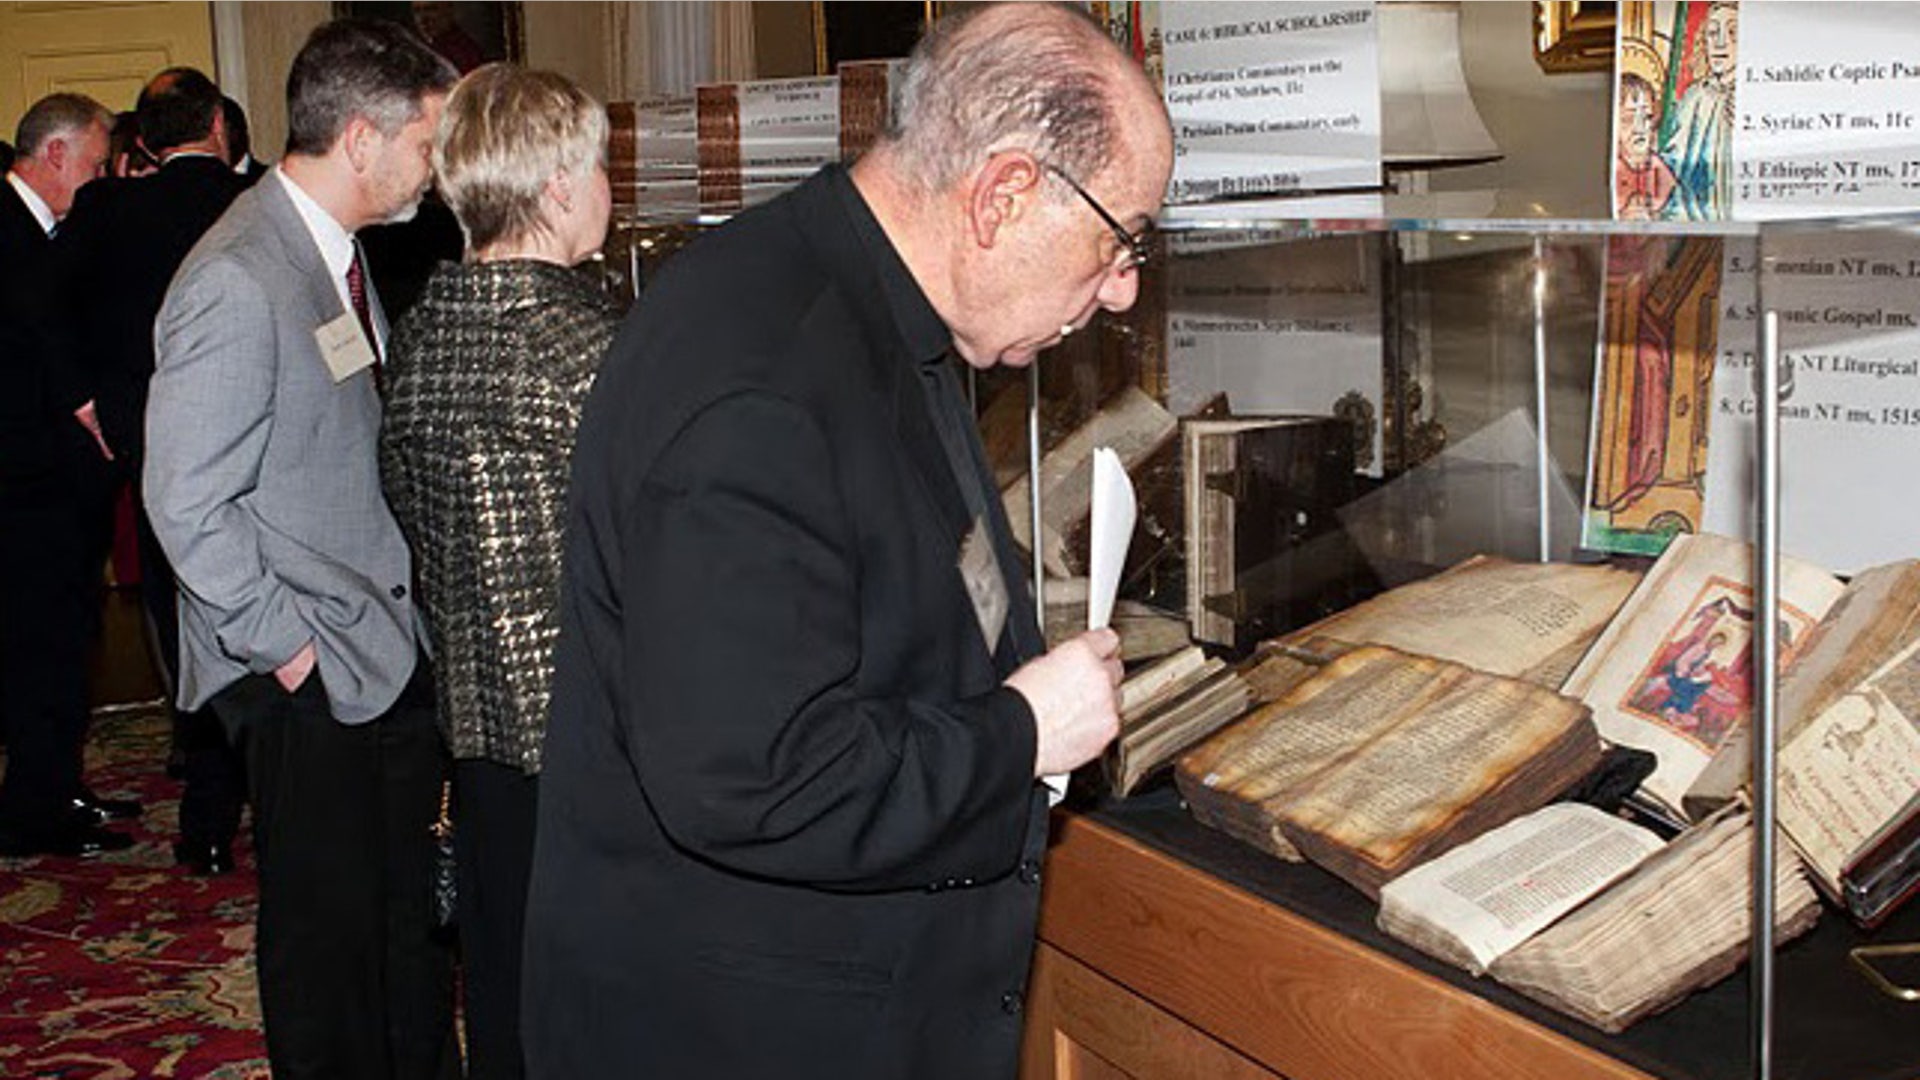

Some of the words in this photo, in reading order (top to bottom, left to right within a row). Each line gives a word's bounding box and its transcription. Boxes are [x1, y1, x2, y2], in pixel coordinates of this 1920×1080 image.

[1165, 29, 1196, 44] CASE
[1213, 20, 1272, 40] BIBLICAL
[1274, 9, 1372, 33] SCHOLARSHIP
[1237, 64, 1306, 82] Commentary
[1324, 60, 1342, 74] the
[1745, 66, 1759, 83] 1.
[1762, 66, 1825, 83] Sahidic
[1829, 63, 1887, 85] Coptic
[1168, 89, 1202, 106] Gospel
[1743, 114, 1756, 131] 2.
[1761, 113, 1815, 134] Syriac
[1819, 112, 1845, 130] NT
[1850, 115, 1880, 129] ms,
[1740, 161, 1753, 179] 3.
[1758, 161, 1828, 181] Ethiopic
[1833, 161, 1860, 178] NT
[1728, 256, 1745, 273] 5.
[1839, 258, 1868, 277] NT
[1726, 304, 1743, 320] 6.
[1824, 306, 1883, 328] Gospel
[1724, 351, 1738, 368] 7.
[1800, 355, 1828, 370] NT
[1832, 355, 1918, 378] Liturgical
[1739, 399, 1810, 419] Gman
[1814, 403, 1843, 421] NT
